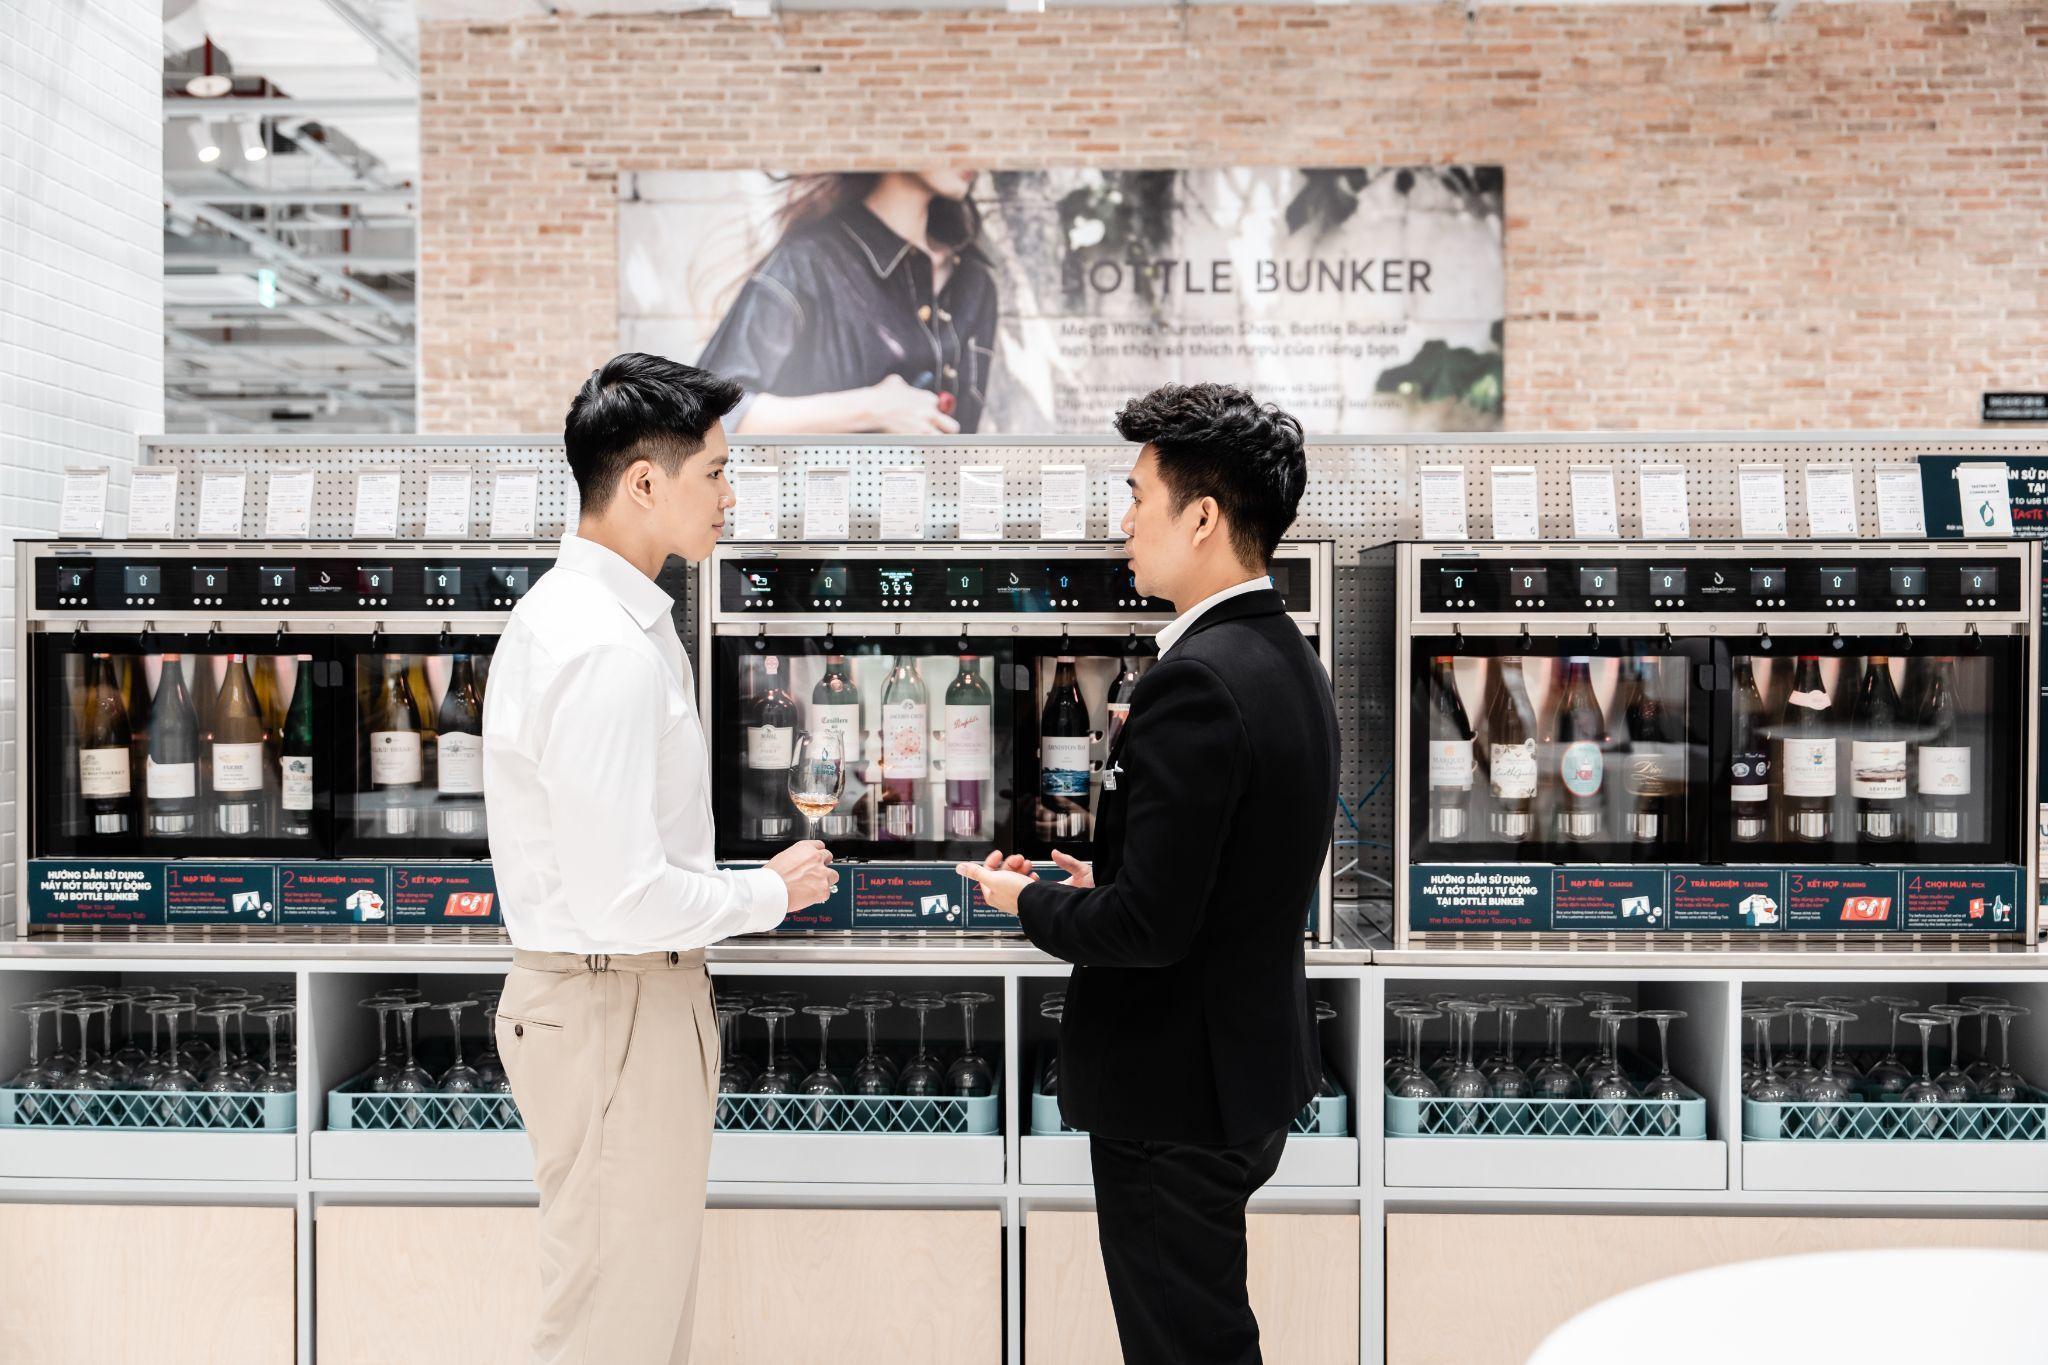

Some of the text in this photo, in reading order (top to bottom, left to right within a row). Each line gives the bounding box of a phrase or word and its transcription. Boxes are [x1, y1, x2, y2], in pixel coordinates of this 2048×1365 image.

[1256, 260, 1431, 293] BUNKER
[1290, 321, 1341, 335] Bottle
[1347, 321, 1407, 335] Bunker
[2021, 467, 2037, 480] SỬ
[2027, 483, 2045, 495] TẠI
[48, 868, 145, 882] HƯỚNG DẪN SỬ DỤNG
[282, 870, 295, 888] 2
[396, 870, 408, 889] 3
[857, 873, 868, 890] 1
[1431, 872, 1530, 886] HƯỚNG DẪN SỬ DỤNG
[41, 880, 152, 892] MÁY RÓT RƯỢU TỰ ĐỘNG
[1556, 874, 1568, 892] 1
[1571, 880, 1587, 888] NẠP
[1588, 878, 1605, 887] TIỀN
[1674, 874, 1686, 893] 2
[1690, 879, 1708, 887] TRẢI
[1709, 879, 1739, 889] NGHIỆM
[1791, 874, 1804, 893] 3
[1807, 879, 1821, 887] KẾT
[1823, 880, 1839, 889] HỢP
[1908, 875, 1922, 892] 4
[1925, 880, 1948, 889] CHỌN
[1949, 880, 1967, 888] MUA
[53, 892, 139, 903] TẠI BOTTLE BUNKER
[1423, 885, 1538, 897] MÁY RÓT RƯỢU TỰ ĐỘNG
[1437, 897, 1525, 907] TẠI BOTTLE BUNKER
[1492, 917, 1516, 925] Tasting
